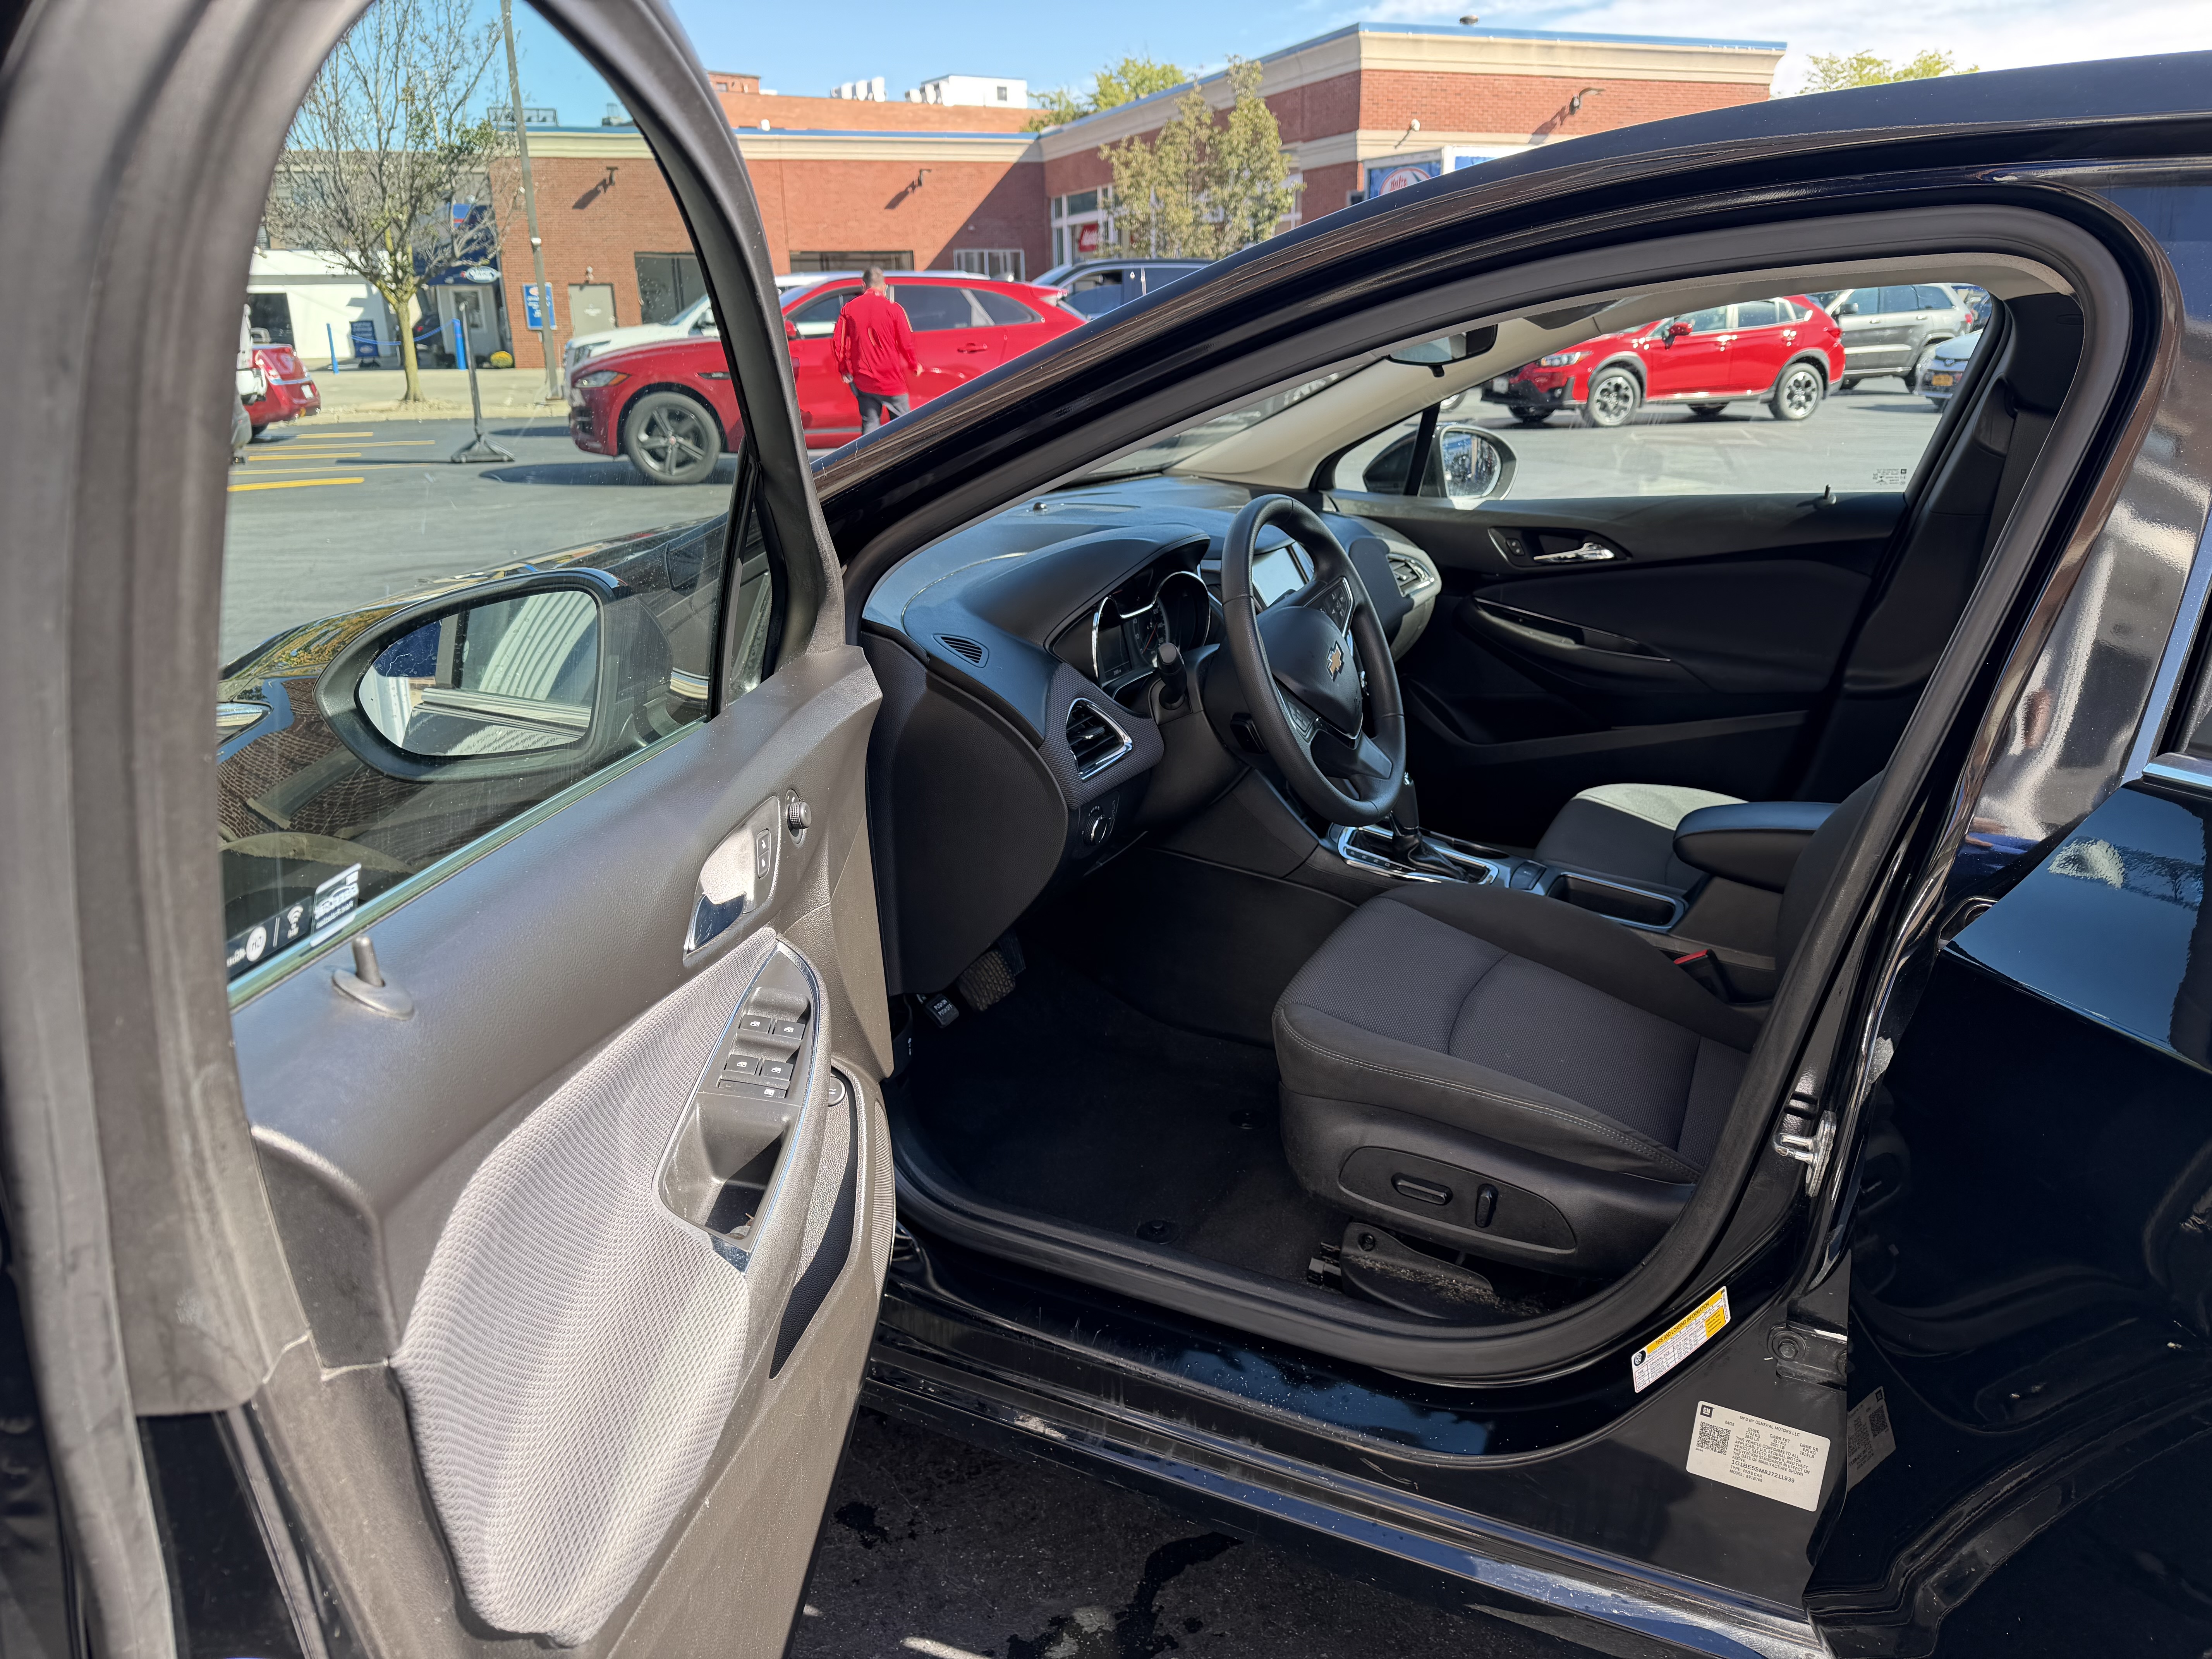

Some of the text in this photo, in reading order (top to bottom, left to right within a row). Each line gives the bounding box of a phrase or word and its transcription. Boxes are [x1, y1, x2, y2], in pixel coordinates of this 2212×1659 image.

[934, 1002, 943, 1010] PUSH
[938, 1007, 948, 1016] PUSH
[1671, 1319, 1686, 1334] LOADING
[1686, 1300, 1709, 1322] INFORMATION
[1755, 1420, 1774, 1429] GENERAL
[1774, 1426, 1791, 1434] MOTORS
[1734, 1444, 1750, 1452] VEHICLE
[1735, 1440, 1760, 1451] APPLICABLE
[1768, 1450, 1786, 1458] FEDERAL
[1745, 1439, 1762, 1447] VEHICLE
[1762, 1444, 1785, 1454] CONFORMS
[1733, 1448, 1758, 1458] PREVENTION
[1759, 1455, 1783, 1466] STANDARDS
[1731, 1459, 1795, 1483] 1G1BE5SM8J7211939
[1758, 1459, 1787, 1471] MANUFACTURE
